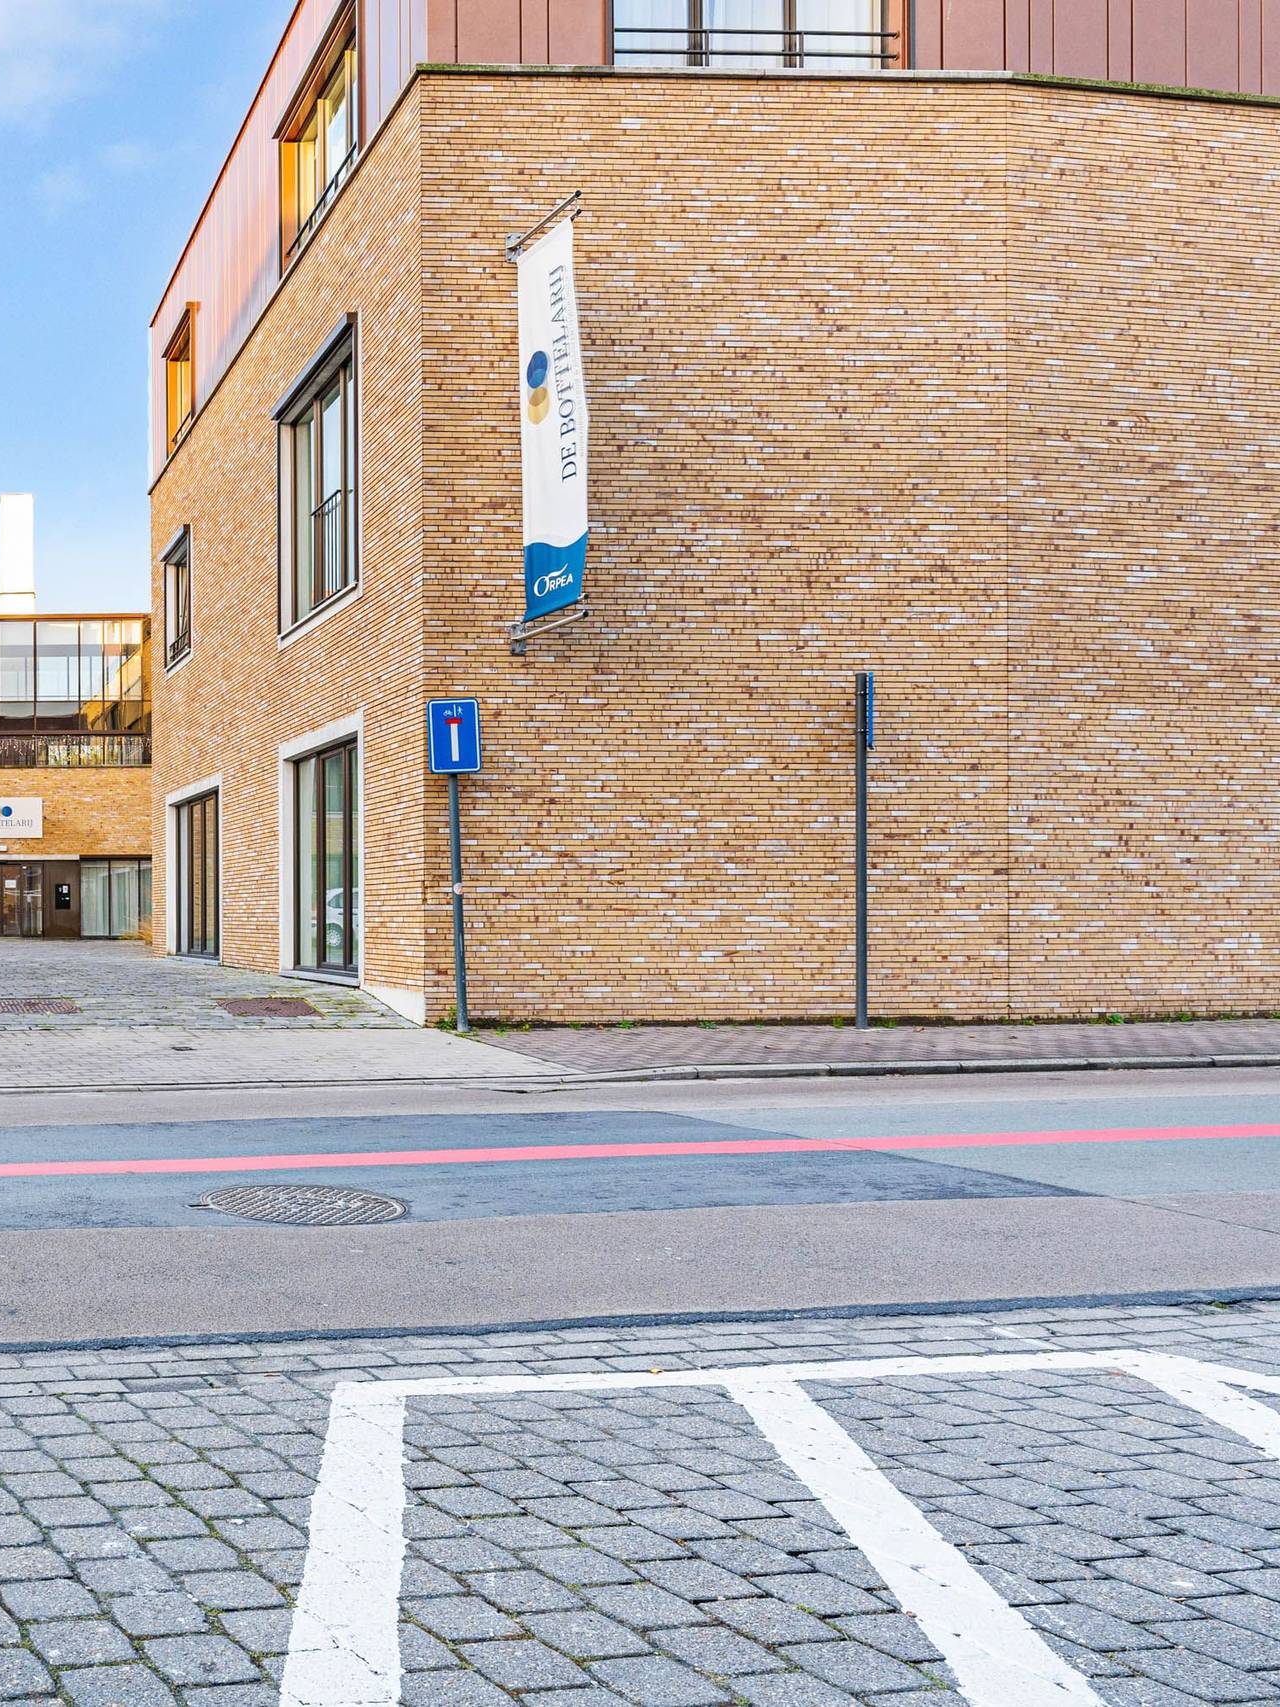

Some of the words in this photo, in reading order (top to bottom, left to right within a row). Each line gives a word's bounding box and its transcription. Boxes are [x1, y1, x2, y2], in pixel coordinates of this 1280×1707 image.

[549, 265, 576, 439] BOTTELARIJ
[561, 442, 577, 483] DE
[533, 563, 574, 597] ORPEA
